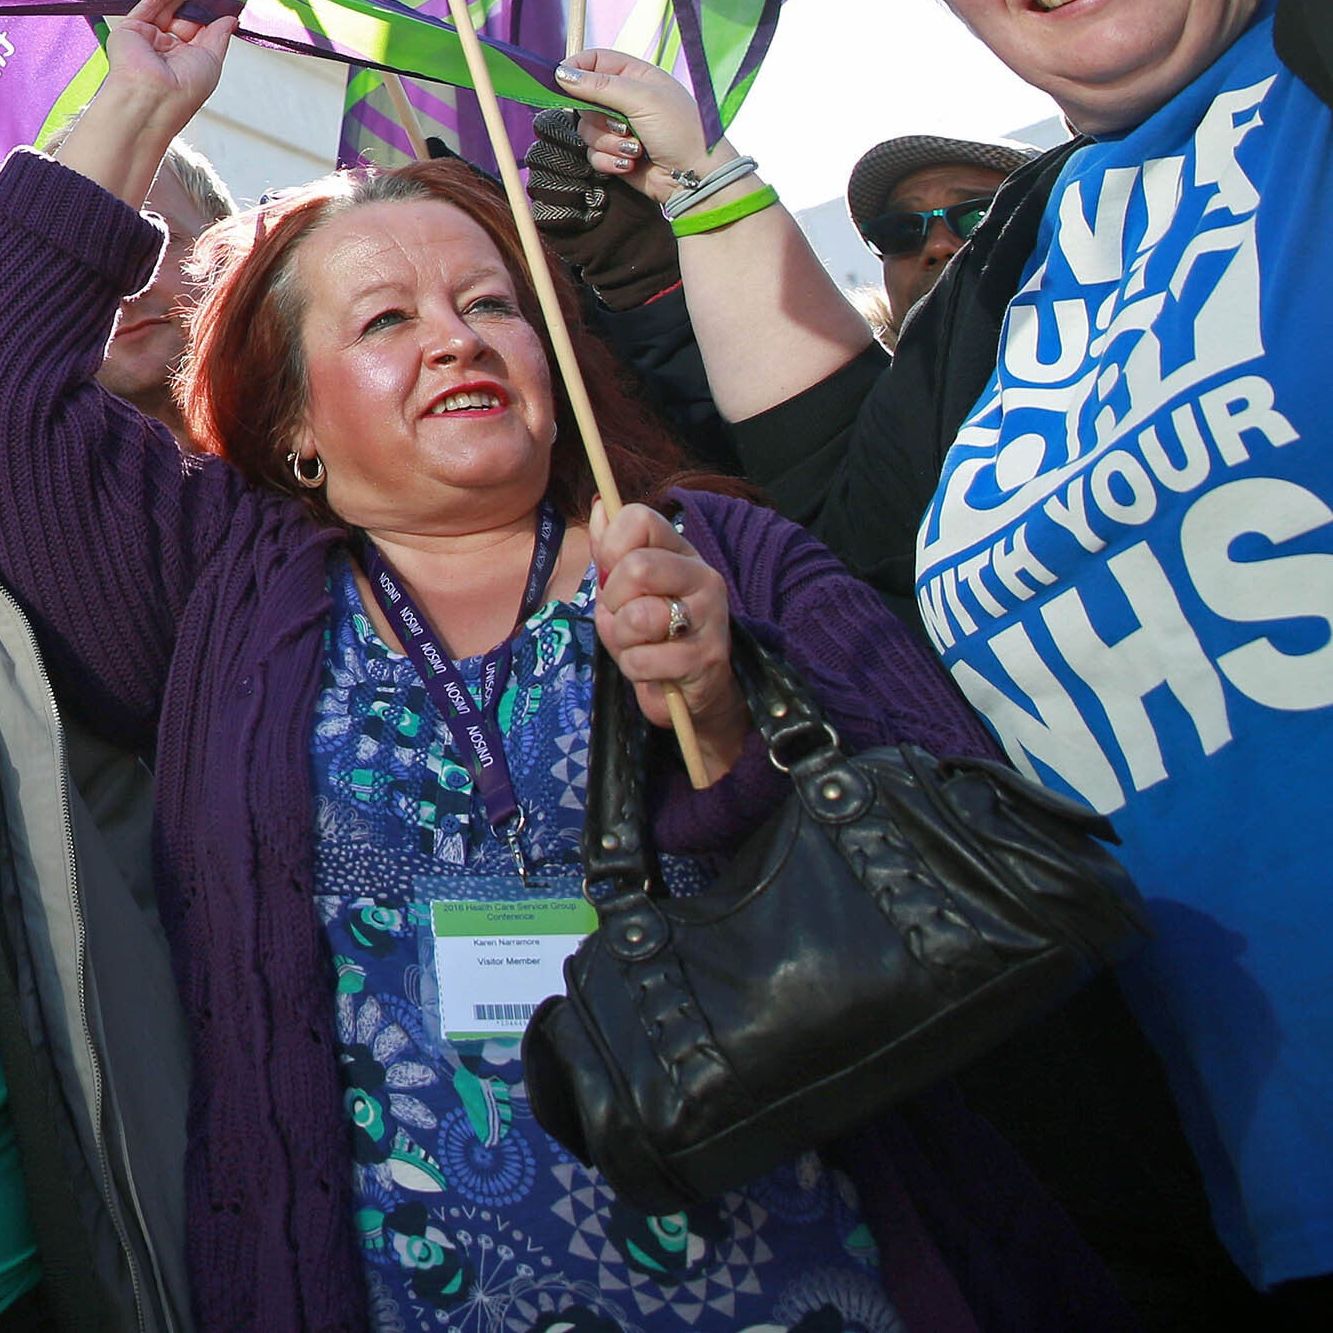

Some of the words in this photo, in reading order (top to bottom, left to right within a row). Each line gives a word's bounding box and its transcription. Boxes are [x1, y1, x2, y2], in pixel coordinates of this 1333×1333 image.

[916, 523, 1059, 656] WITH
[1044, 375, 1301, 554] YOUR
[379, 572, 402, 604] UNISON
[399, 606, 424, 637] UNISON
[420, 642, 447, 675] UNISON
[950, 477, 1333, 816] NHS
[443, 681, 471, 715] UNISON
[466, 725, 494, 768] UNISON
[466, 903, 494, 912] Health
[494, 902, 516, 912] Care
[517, 901, 549, 911] Service
[550, 901, 578, 911] Group
[486, 912, 536, 922] Conference
[473, 938, 497, 947] Karen
[477, 956, 504, 966] Visitor
[505, 956, 542, 966] Member
